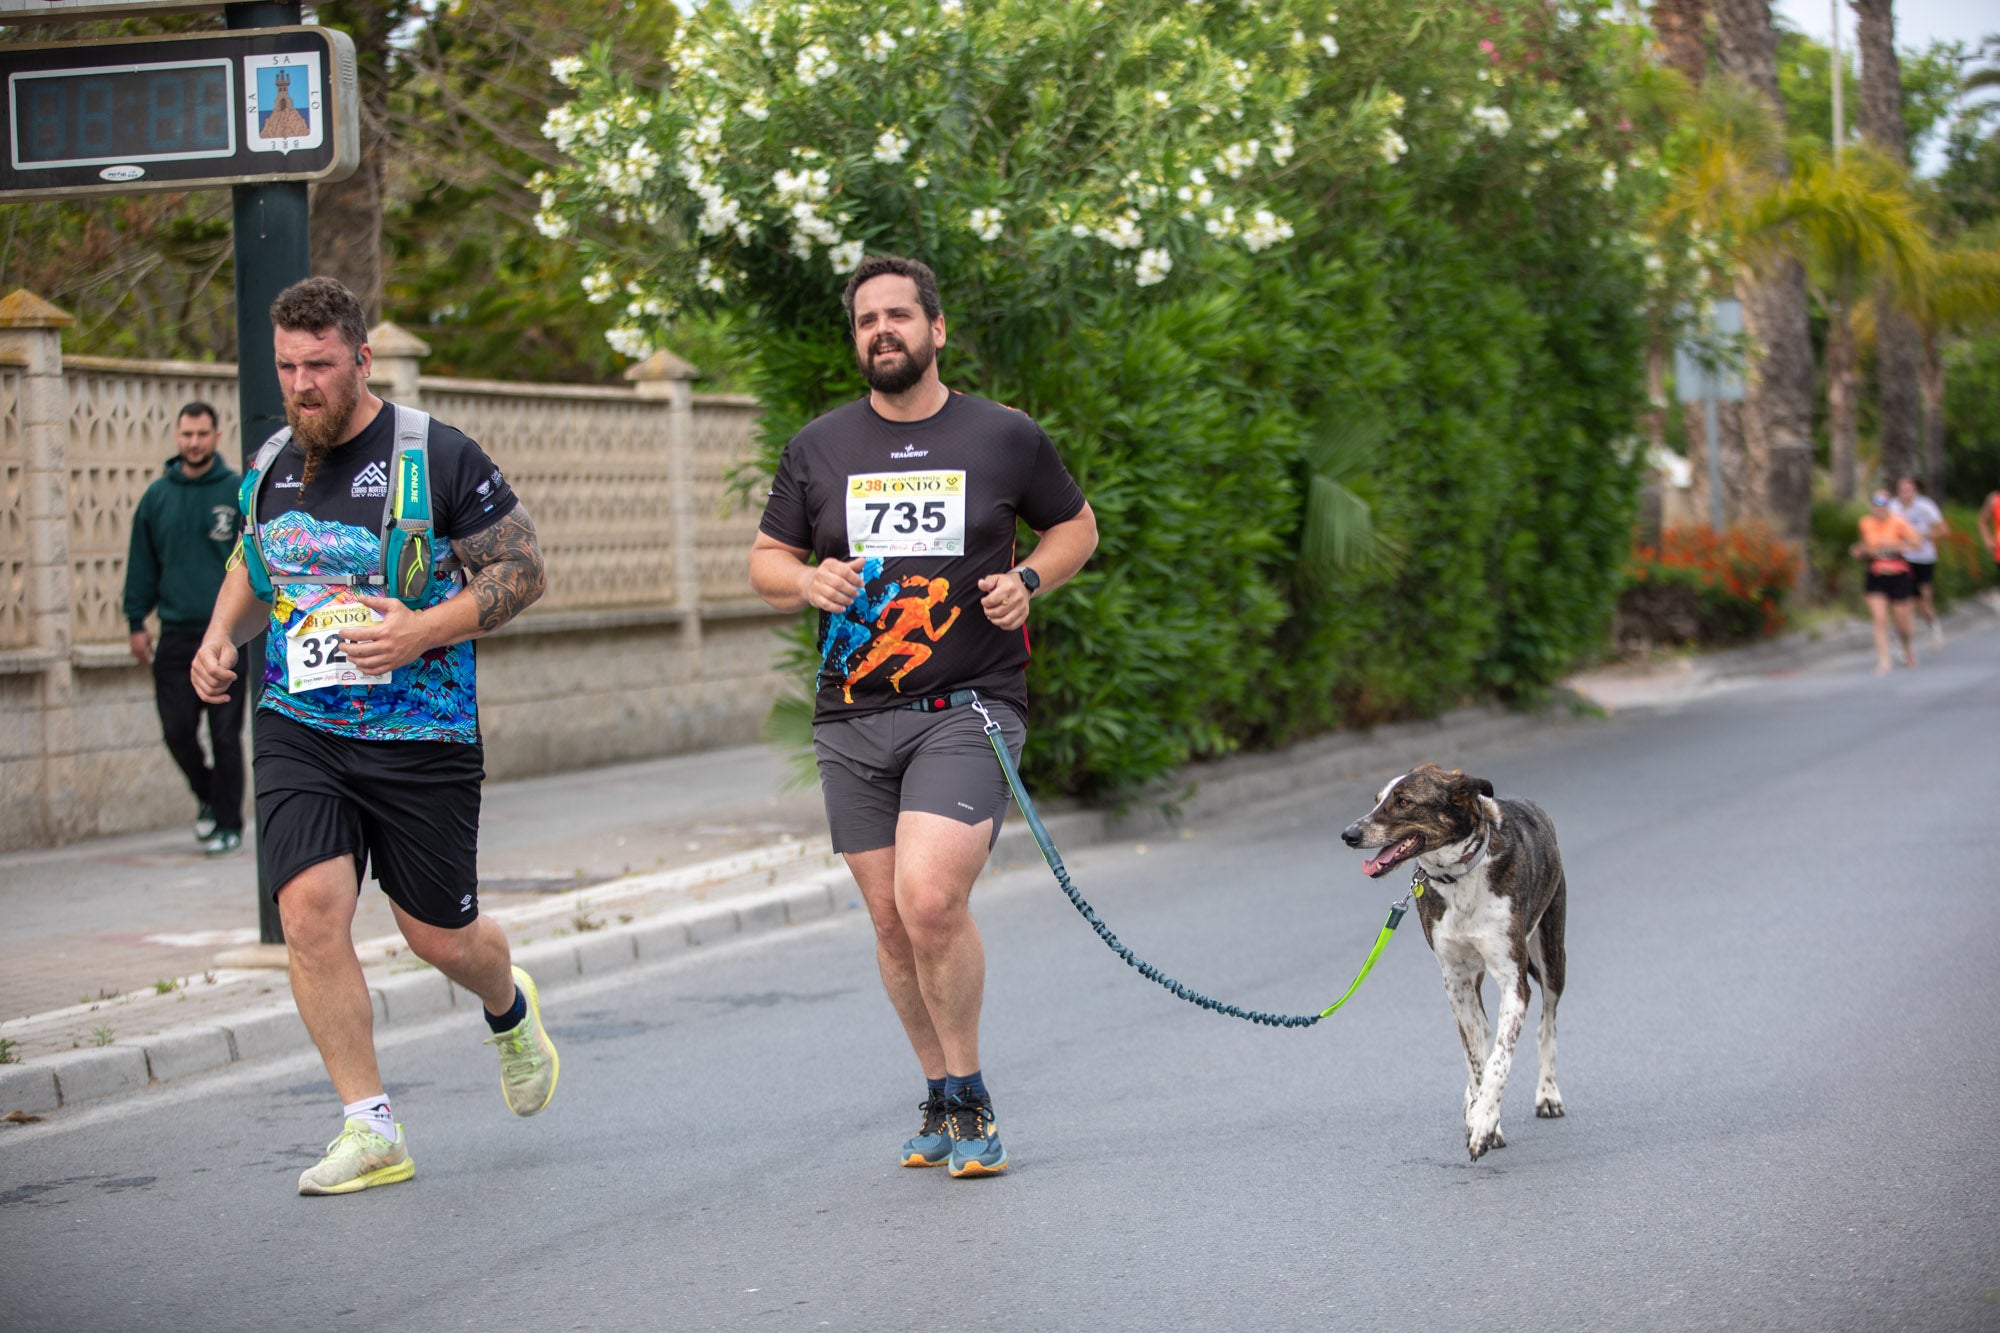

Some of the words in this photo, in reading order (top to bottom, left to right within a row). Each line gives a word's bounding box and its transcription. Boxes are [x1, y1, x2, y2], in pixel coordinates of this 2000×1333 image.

[890, 450, 929, 459] TEAMERGY
[864, 479, 882, 492] 38
[865, 501, 947, 535] 735
[302, 633, 358, 669] 32
